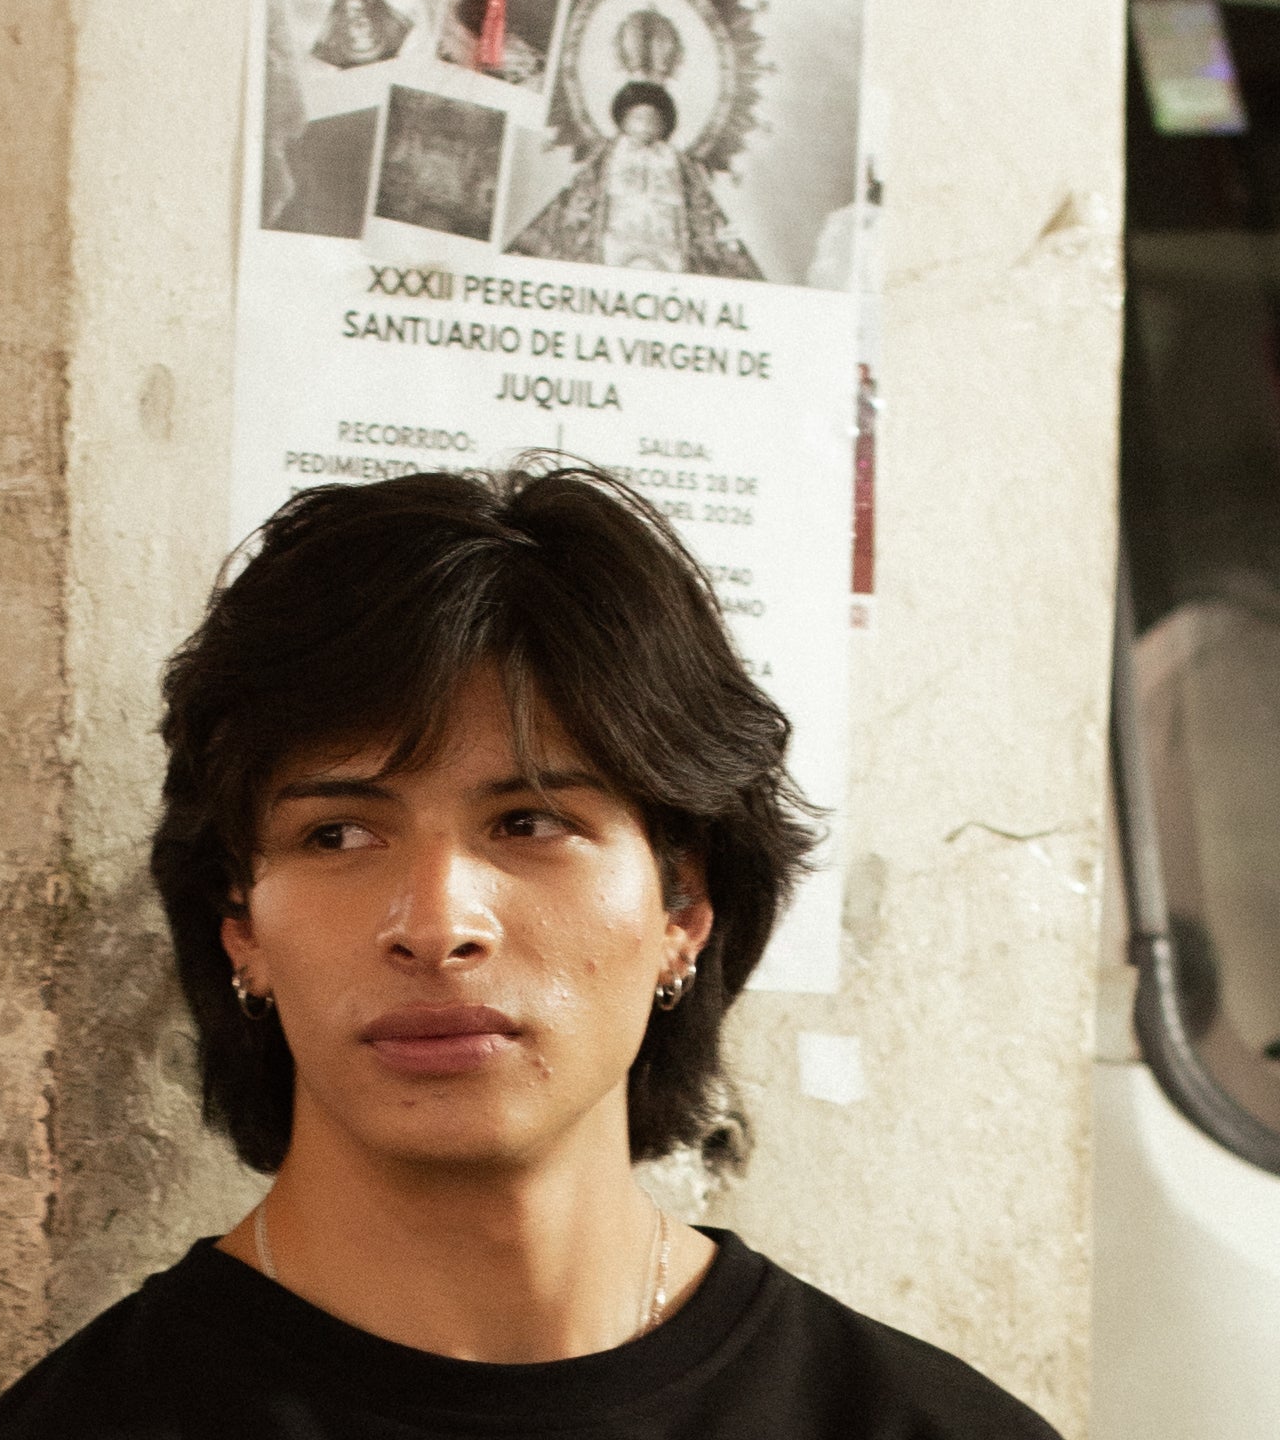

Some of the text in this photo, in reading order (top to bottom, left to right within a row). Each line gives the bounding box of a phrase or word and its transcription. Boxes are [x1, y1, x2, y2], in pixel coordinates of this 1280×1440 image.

[366, 265, 749, 331] XXXII PEREGRINACIÓN AL
[341, 310, 772, 379] SANTUARIO DE LA VIRGEN DE
[494, 372, 623, 410] JUQUILA
[338, 421, 477, 452] RECORRIDO:
[735, 475, 759, 496] DE
